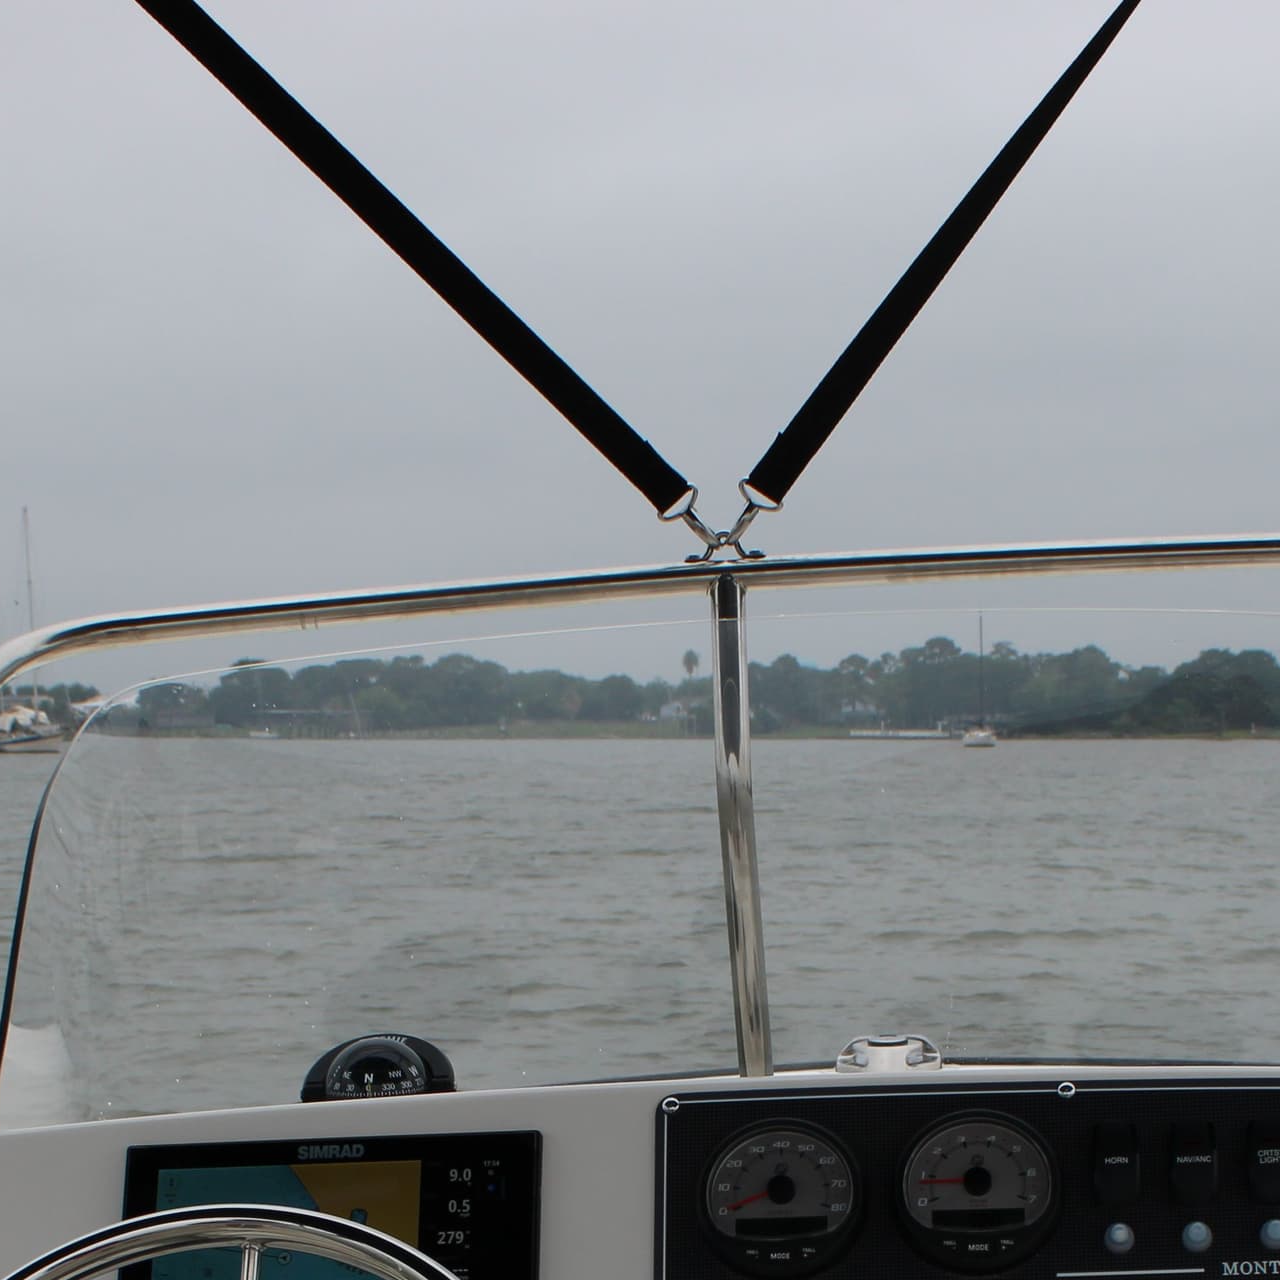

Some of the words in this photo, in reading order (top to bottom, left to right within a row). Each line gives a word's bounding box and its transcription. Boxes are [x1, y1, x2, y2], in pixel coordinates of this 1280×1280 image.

[364, 1073, 374, 1083] N
[389, 1070, 402, 1078] NW
[772, 1140, 791, 1148] 40
[797, 1144, 815, 1152] 50
[297, 1144, 365, 1160] SIMRAD
[748, 1145, 765, 1153] 30
[725, 1159, 743, 1168] 20
[819, 1156, 836, 1165] 60
[1104, 1156, 1128, 1165] HORN
[1176, 1154, 1211, 1164] NAV/ANC
[449, 1168, 472, 1182] 9.0
[1027, 1168, 1037, 1176] 6
[718, 1183, 730, 1192] 10
[831, 1179, 847, 1188] 70
[918, 1197, 928, 1207] 0
[1026, 1194, 1037, 1203] 7
[448, 1199, 471, 1213] 0.5
[830, 1203, 847, 1212] 80
[718, 1207, 728, 1216] 0
[436, 1230, 464, 1245] 279
[967, 1243, 989, 1251] MODE
[769, 1252, 790, 1260] MODE
